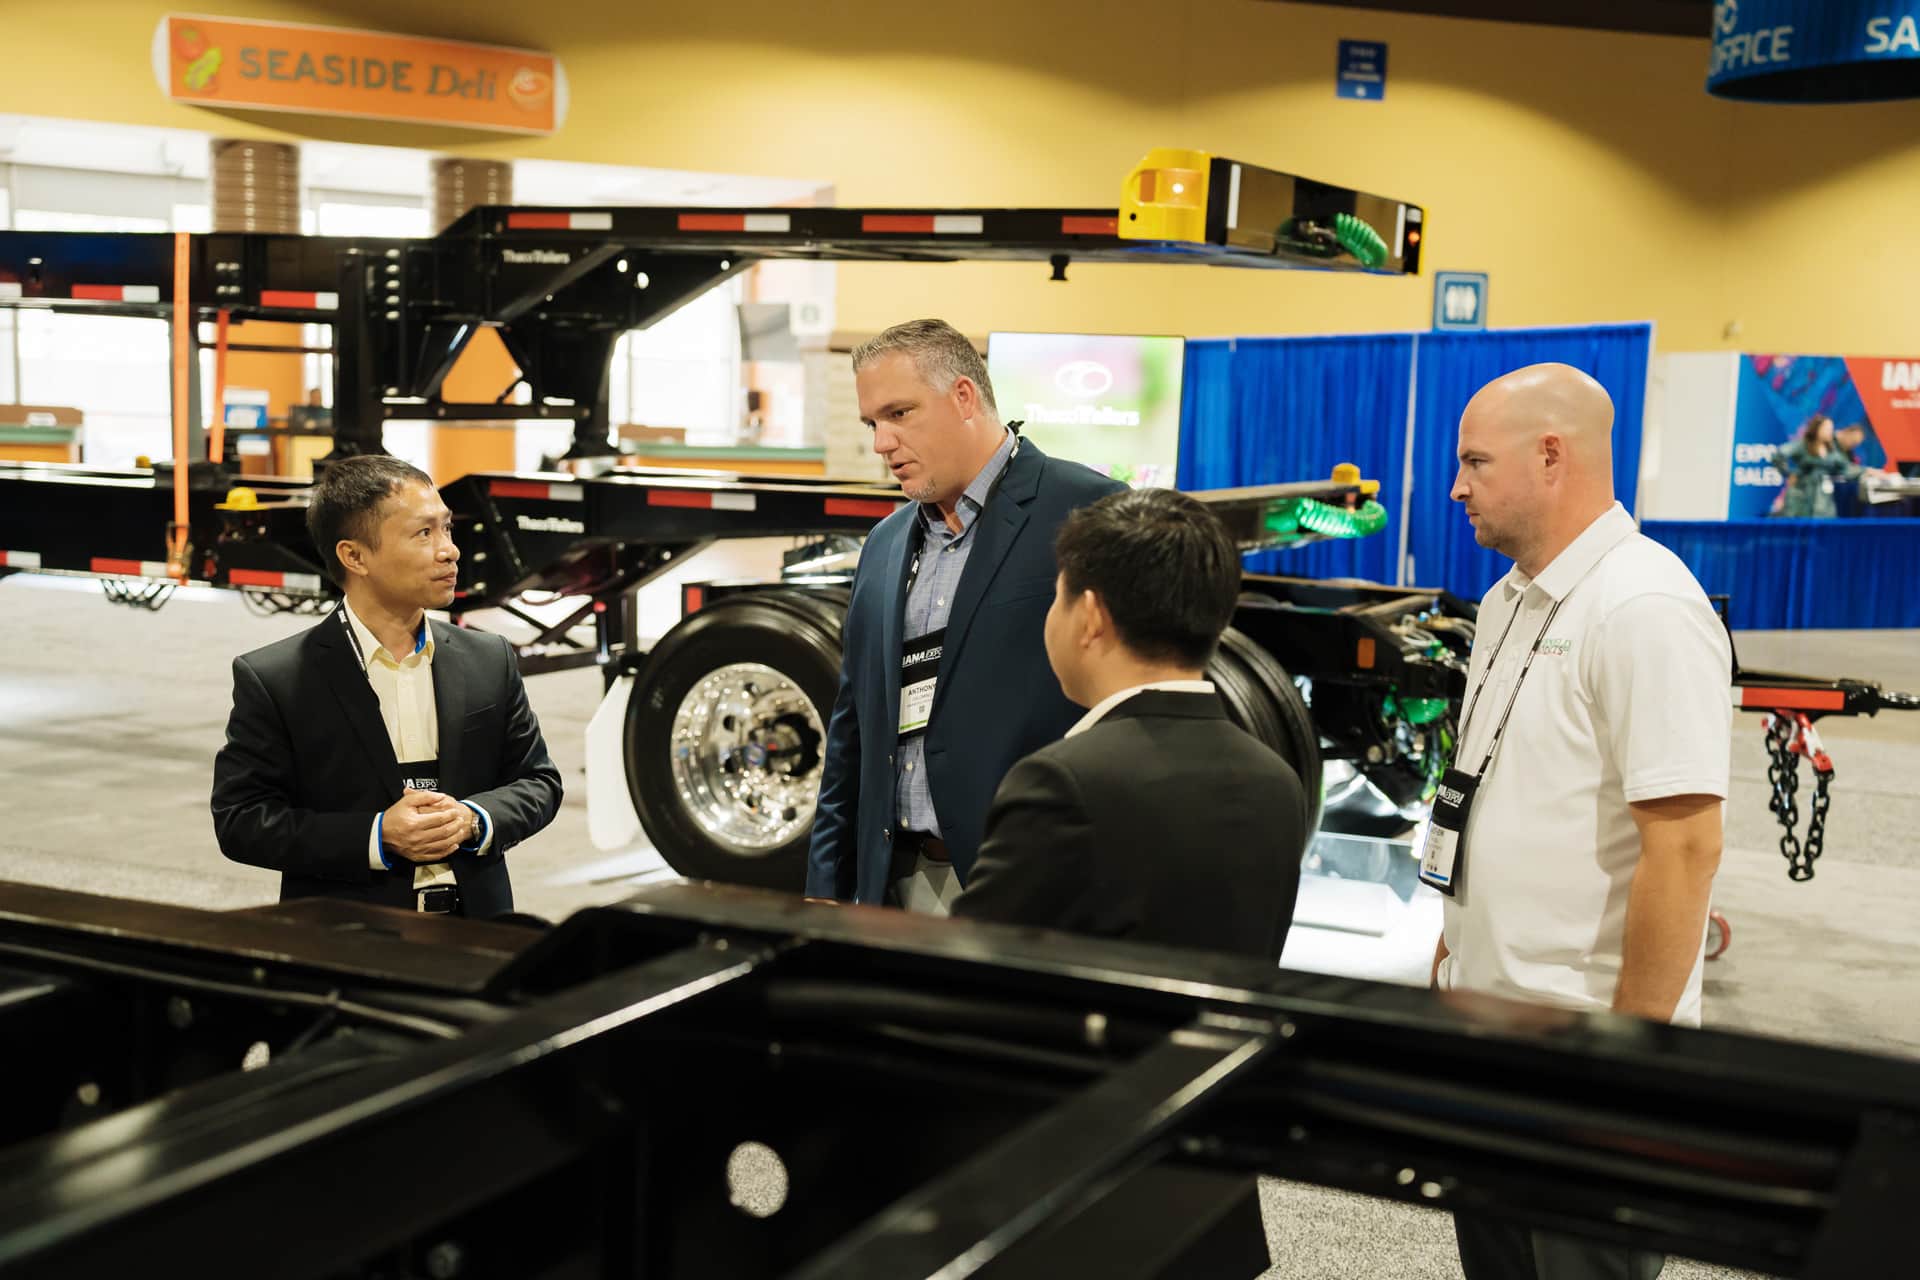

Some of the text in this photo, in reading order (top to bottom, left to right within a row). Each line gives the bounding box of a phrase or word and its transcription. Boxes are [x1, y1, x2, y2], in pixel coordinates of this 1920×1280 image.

[238, 46, 498, 102] SEASIDE Deli
[1734, 466, 1784, 487] SALES
[416, 781, 437, 789] EXPO
